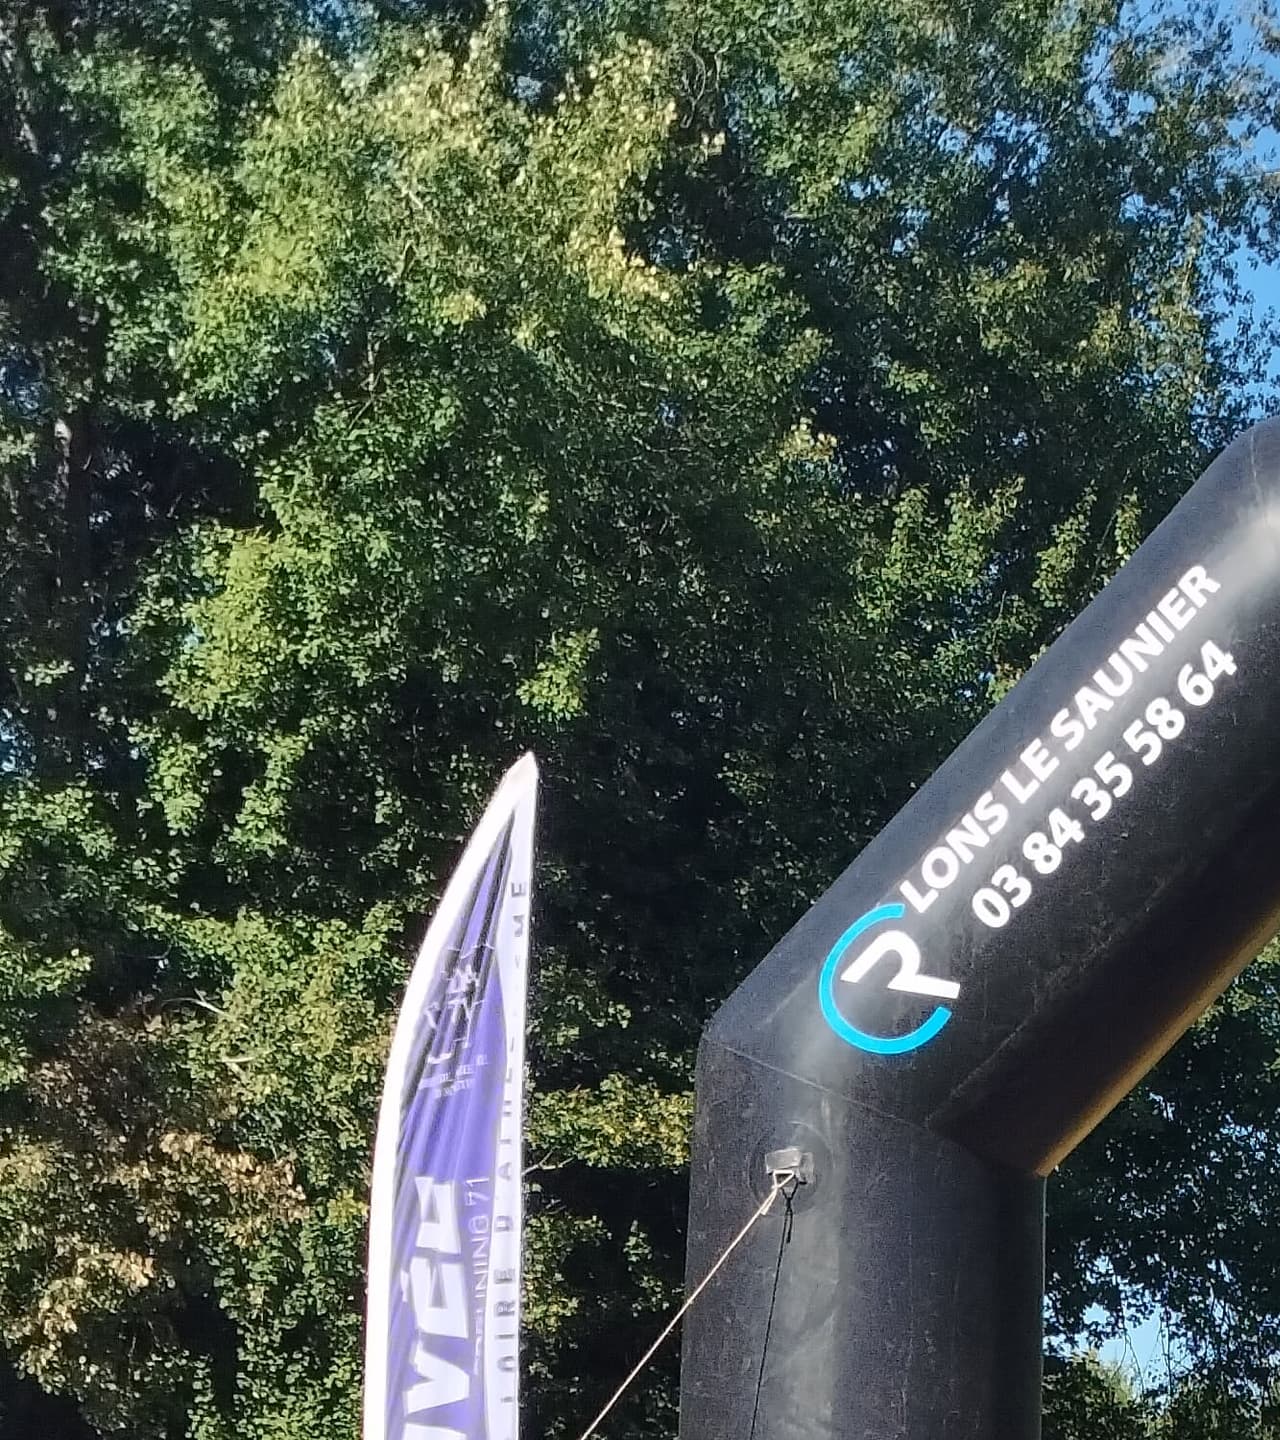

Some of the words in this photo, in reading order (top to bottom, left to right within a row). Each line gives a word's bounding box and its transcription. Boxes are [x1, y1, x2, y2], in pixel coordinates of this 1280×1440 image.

[900, 792, 1009, 914] LONS
[1001, 739, 1060, 804] LE
[1050, 565, 1222, 751] SAUNIER
[971, 865, 1032, 928] 03
[1022, 807, 1085, 874] 84
[1071, 751, 1133, 821] 35
[1123, 696, 1186, 765] 58
[1177, 639, 1238, 707] 64
[464, 1175, 491, 1206] 71
